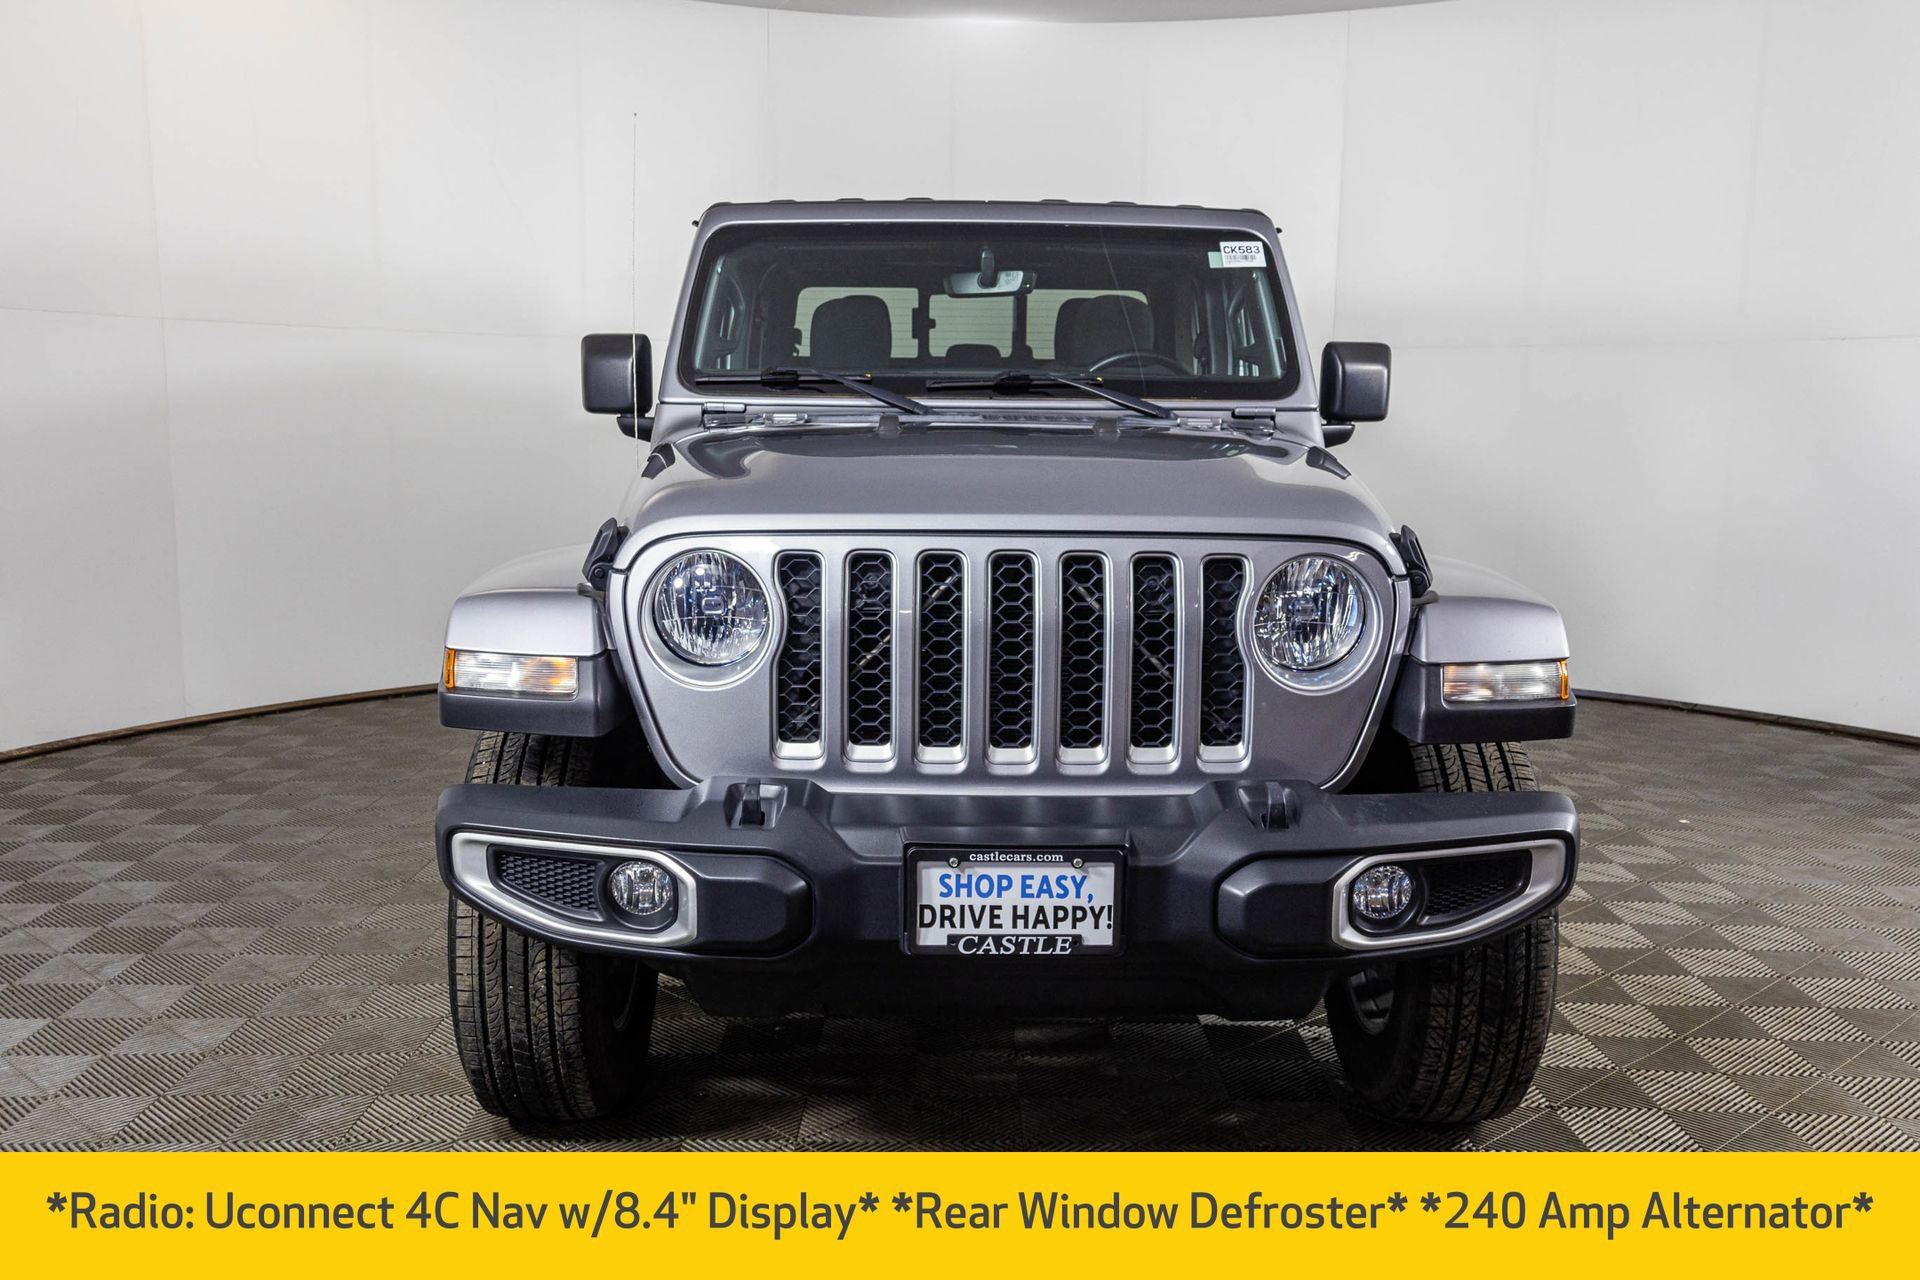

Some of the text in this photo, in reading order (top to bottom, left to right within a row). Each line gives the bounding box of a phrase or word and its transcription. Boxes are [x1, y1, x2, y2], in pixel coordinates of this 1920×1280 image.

[1223, 245, 1260, 254] CK583
[969, 851, 1064, 862] castlecars.com
[939, 873, 1094, 904] SHOP EASY,
[919, 904, 1113, 930] DRIVE HAPPY!
[957, 935, 1073, 955] CASTLE
